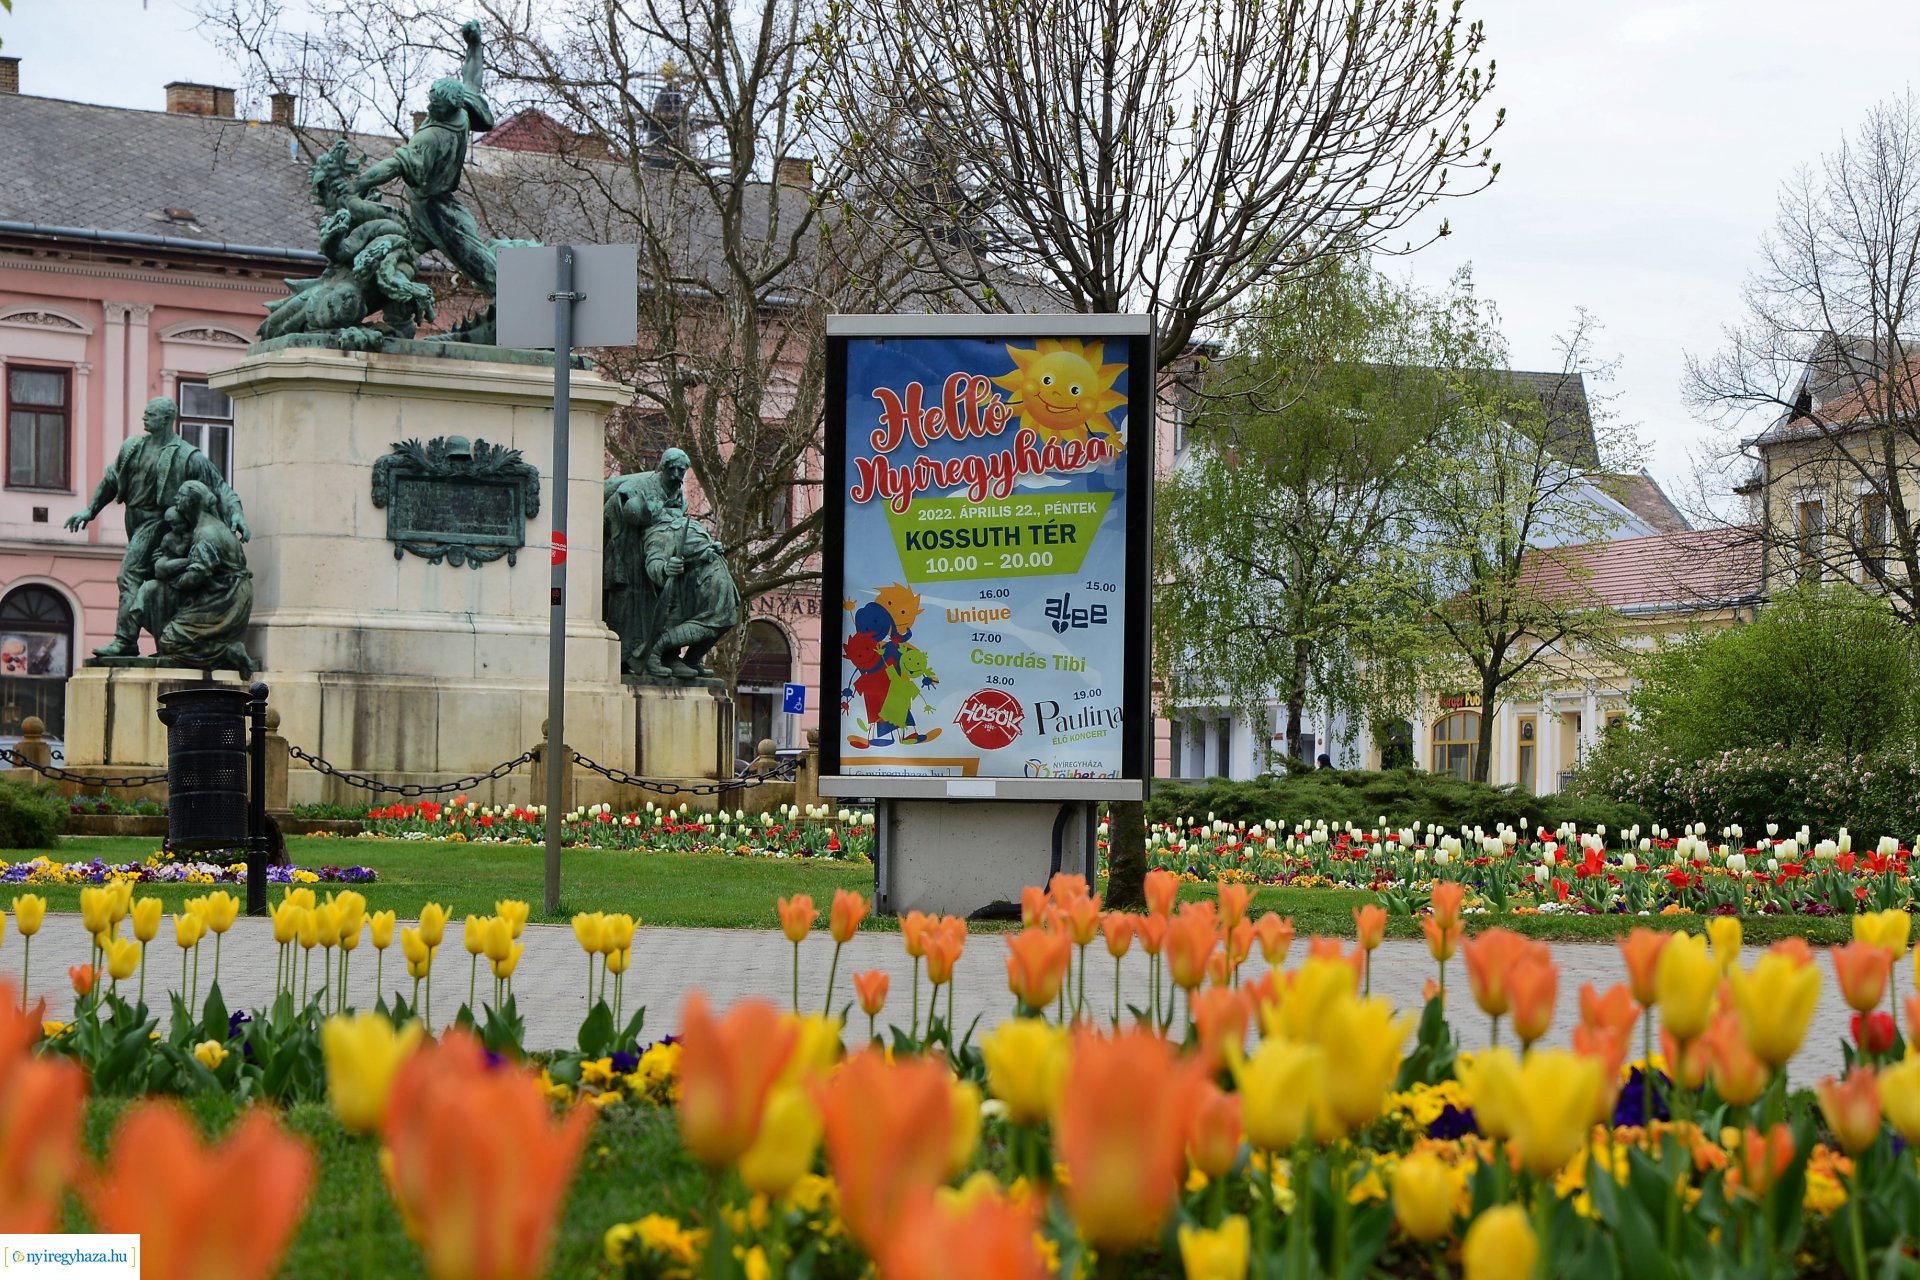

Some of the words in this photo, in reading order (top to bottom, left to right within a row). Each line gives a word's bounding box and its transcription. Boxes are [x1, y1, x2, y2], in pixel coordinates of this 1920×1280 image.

[870, 372, 1012, 452] Helló
[850, 429, 1114, 514] Nyíregyháza
[918, 508, 956, 521] 2022.
[960, 504, 1012, 519] ÁPRILIS
[1015, 504, 1041, 518] 22.,
[1044, 501, 1097, 515] PÉNTEK
[906, 525, 1020, 551] KOSSUTH
[1028, 519, 1077, 545] TÉR
[925, 556, 977, 573] 10.00
[1000, 551, 1053, 569] 20.00
[979, 588, 1010, 599] 16.00
[1086, 580, 1116, 593] 15.00
[946, 606, 1012, 624] Unique
[971, 632, 1002, 644] 17.00
[970, 648, 1047, 670] Csordás
[1052, 654, 1086, 673] Tibi
[985, 675, 1015, 686] 18.00
[785, 687, 794, 701] P
[1073, 688, 1102, 700] 19.00
[1465, 690, 1481, 706] Pub
[1034, 700, 1124, 736] Paulina
[1052, 735, 1068, 746] ÉLŐ
[1069, 729, 1108, 742] KONCERT
[1053, 760, 1103, 769] NYÍREGYHÁZA
[1052, 769, 1096, 779] Többet
